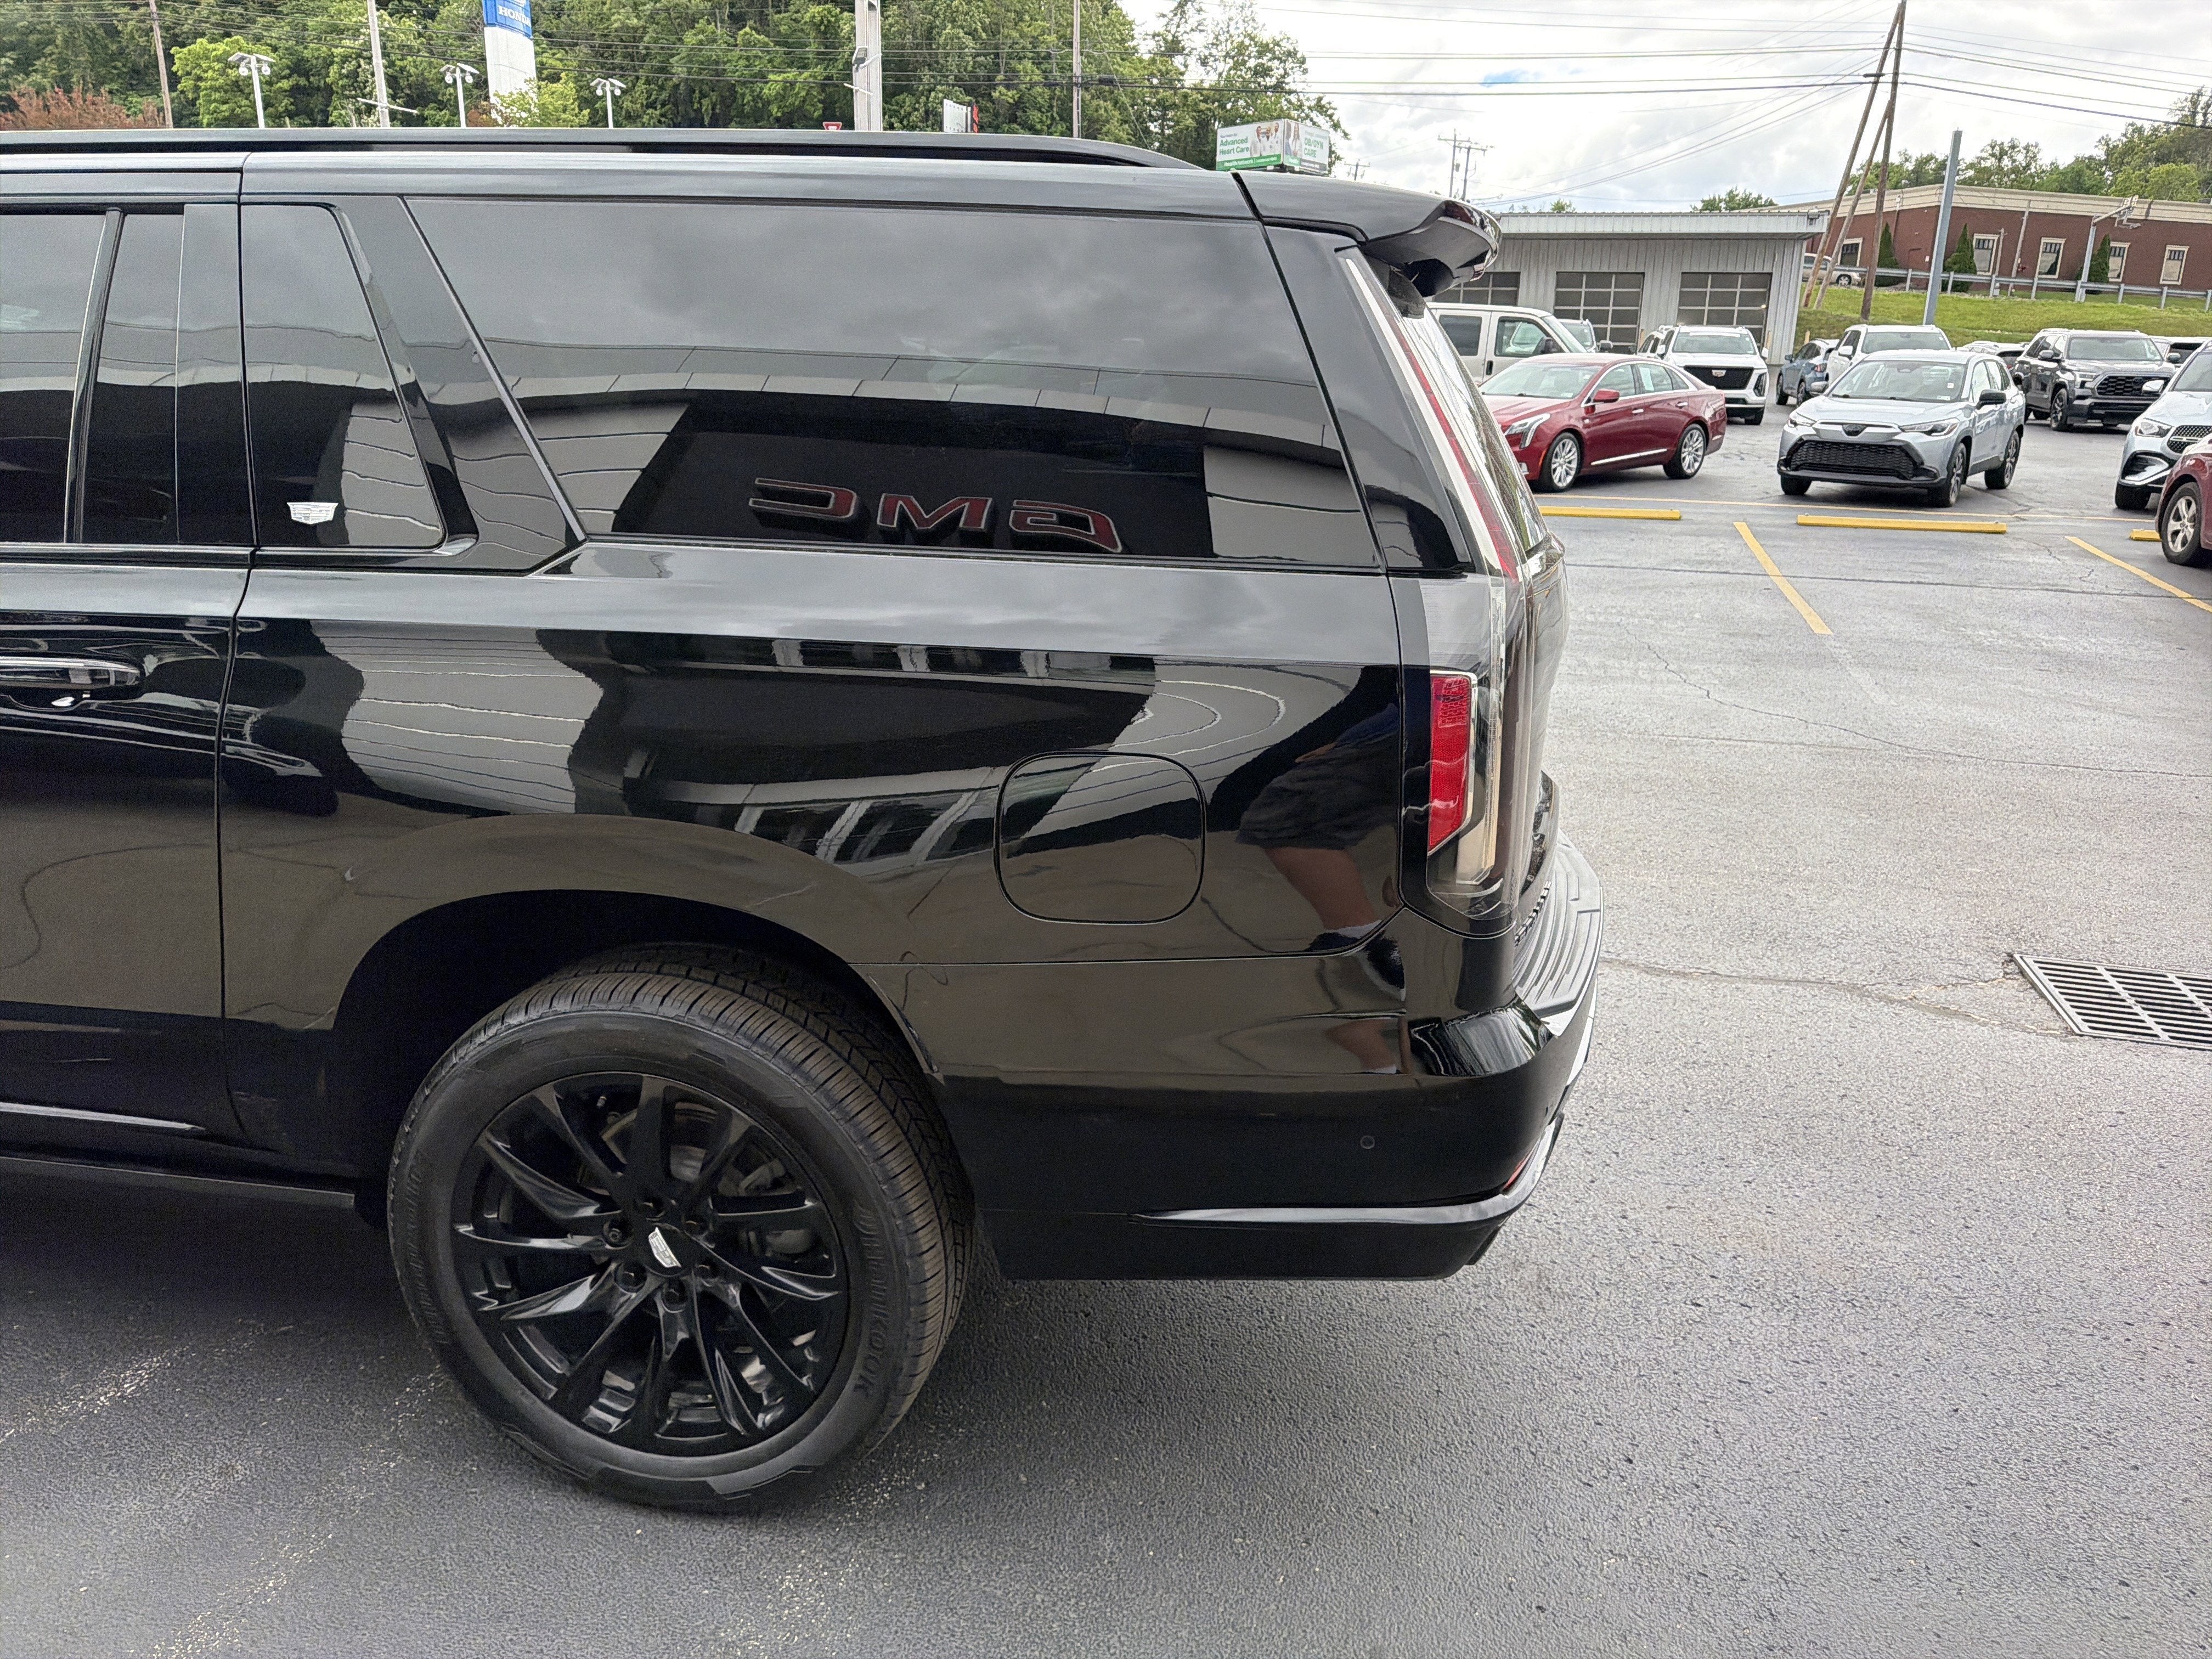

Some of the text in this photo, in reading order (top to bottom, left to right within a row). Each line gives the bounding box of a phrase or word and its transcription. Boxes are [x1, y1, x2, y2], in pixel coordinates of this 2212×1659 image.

[497, 5, 531, 28] HONDA
[1219, 136, 1248, 147] Advanced
[1219, 147, 1235, 155] Heart
[1304, 147, 1317, 158] CARE
